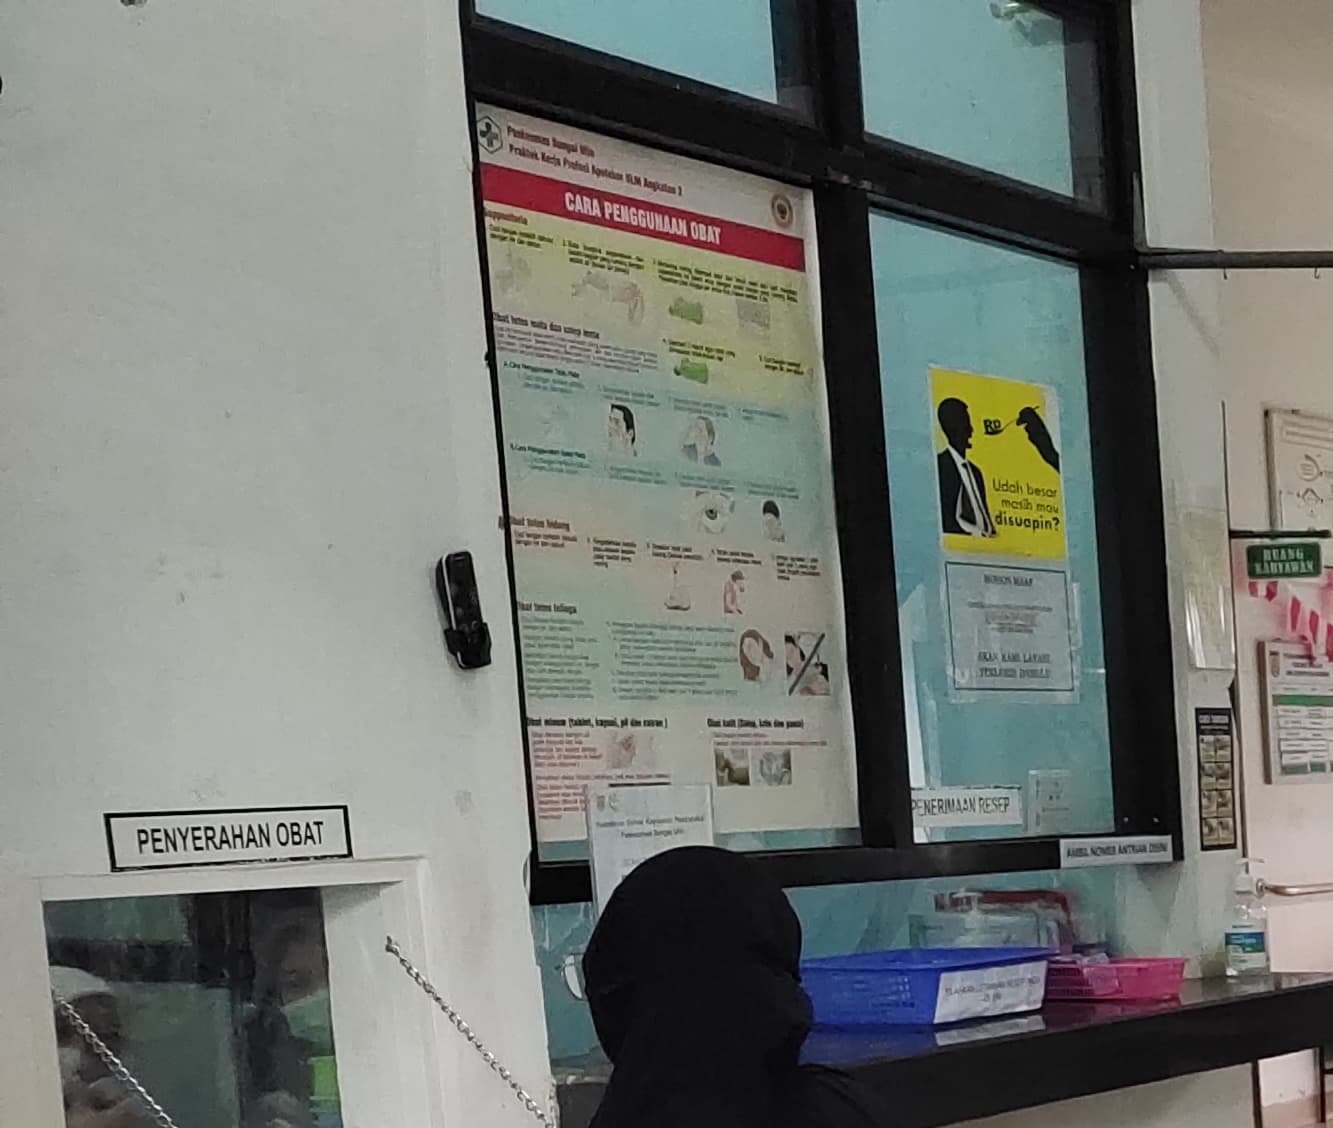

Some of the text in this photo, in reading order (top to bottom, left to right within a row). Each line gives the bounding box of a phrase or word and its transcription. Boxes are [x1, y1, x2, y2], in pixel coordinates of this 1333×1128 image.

[565, 192, 720, 244] CARA PENGGUNAAN OBAT
[992, 478, 1057, 498] Udah besar
[1001, 498, 1059, 514] masih mau
[995, 511, 1060, 532] disuapin?
[912, 796, 1010, 816] PENERIMAAN RESEP
[137, 821, 324, 854] PENYERAHAN OBAT
